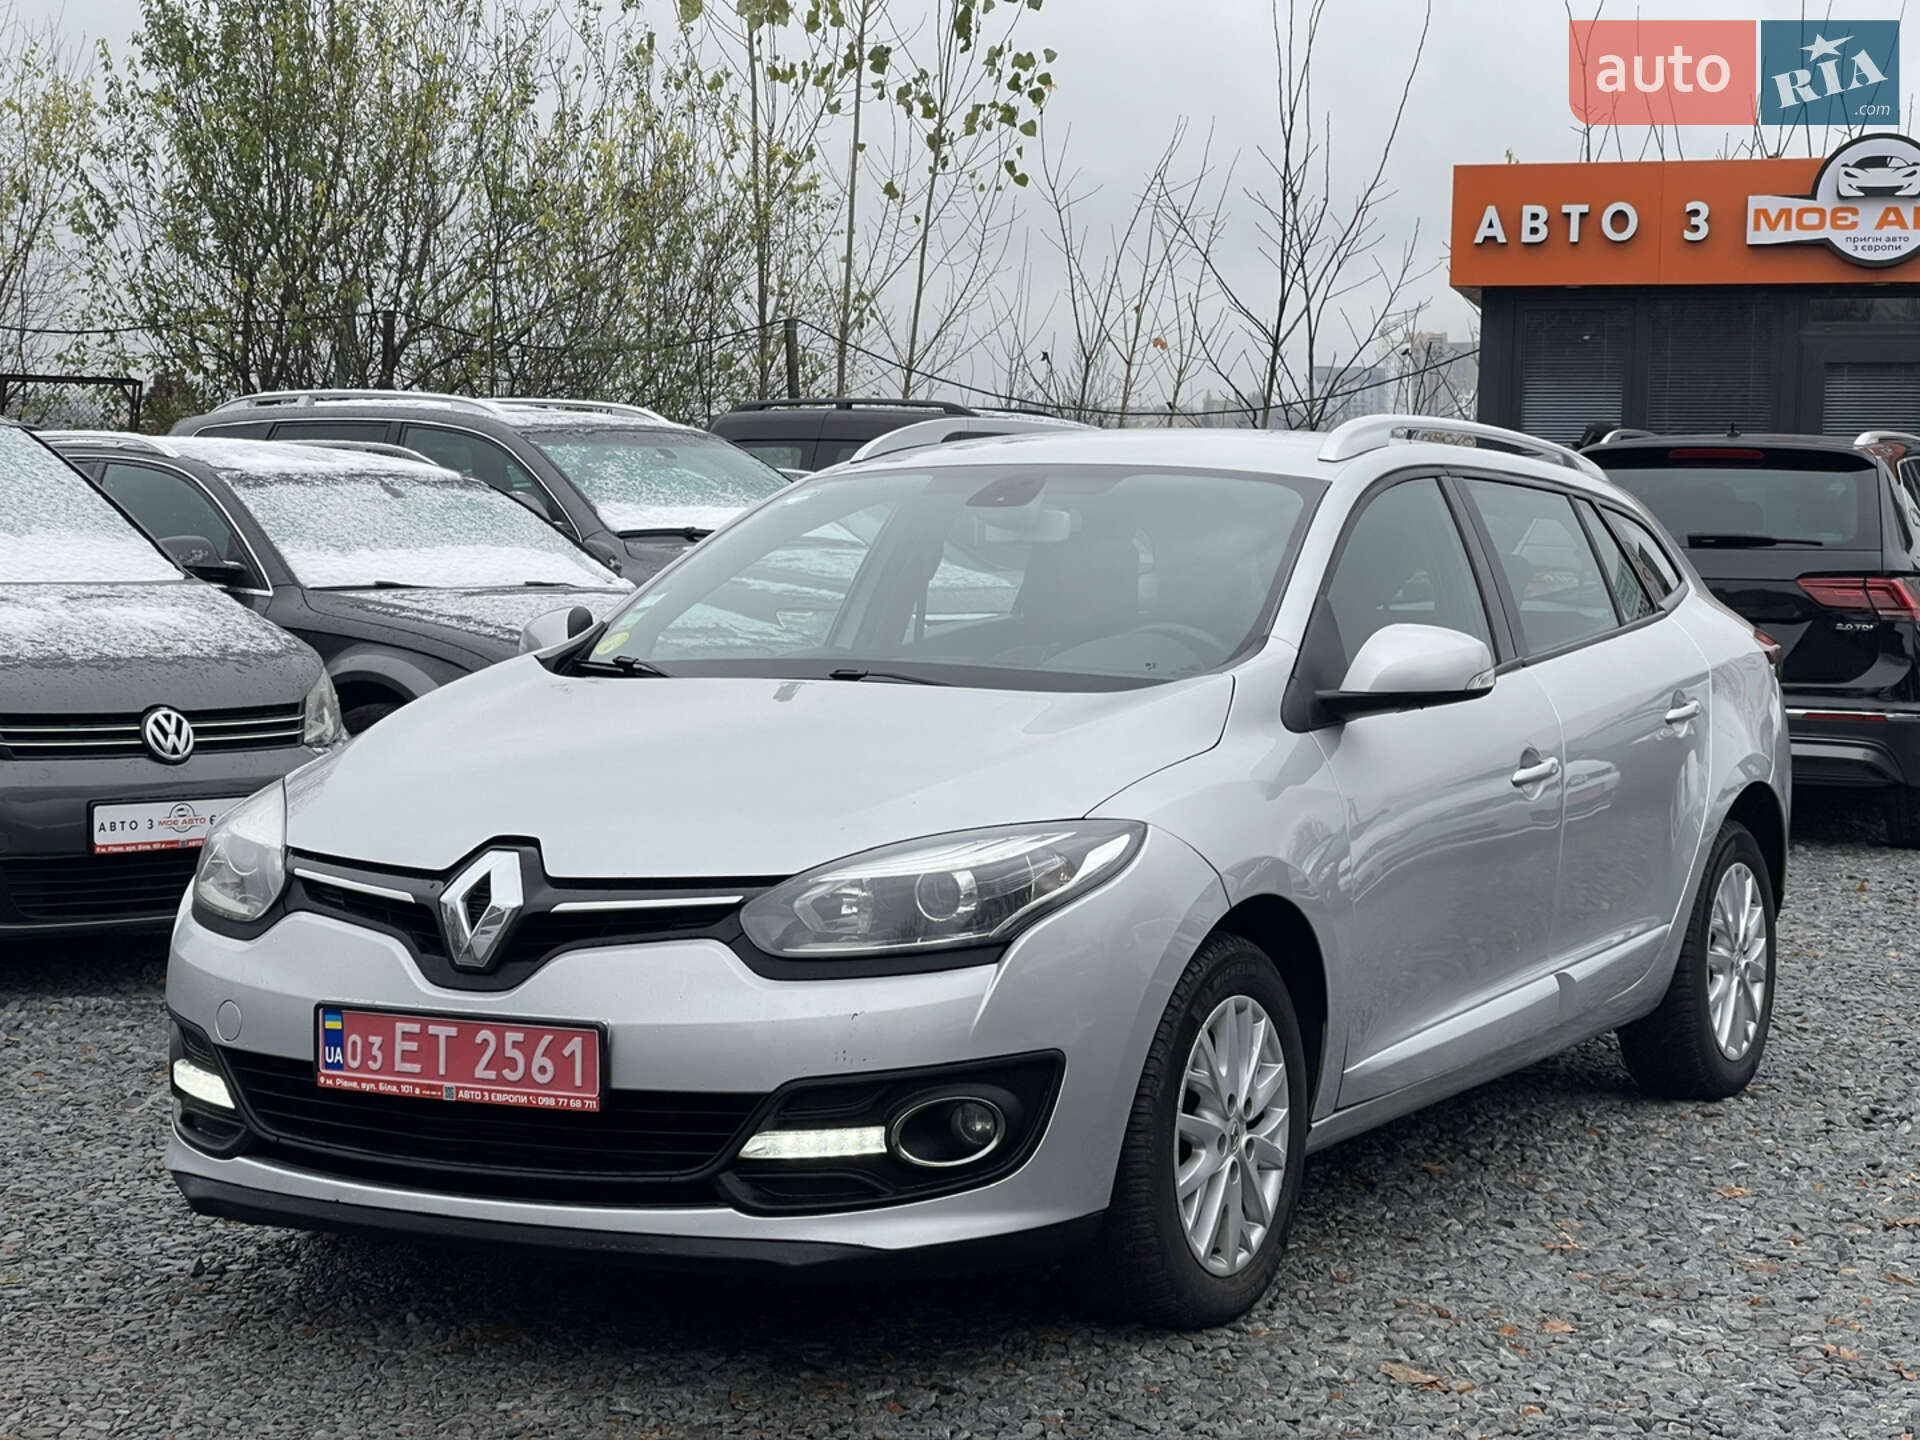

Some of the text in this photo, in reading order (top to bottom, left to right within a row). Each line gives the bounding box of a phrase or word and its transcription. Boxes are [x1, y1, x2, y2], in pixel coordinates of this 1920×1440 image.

[1473, 202, 1639, 245] АВТО
[1753, 205, 1920, 232] МОЄ А
[1845, 236, 1882, 244] пригін
[98, 820, 138, 833] АВТО
[181, 817, 206, 825] АВТО
[325, 1046, 343, 1064] UA
[346, 1022, 583, 1087] 03 ET 2561
[458, 1089, 481, 1101] АВТО
[491, 1092, 527, 1104] ЄВРОПИ
[538, 1096, 597, 1109] 098 77 68 711
